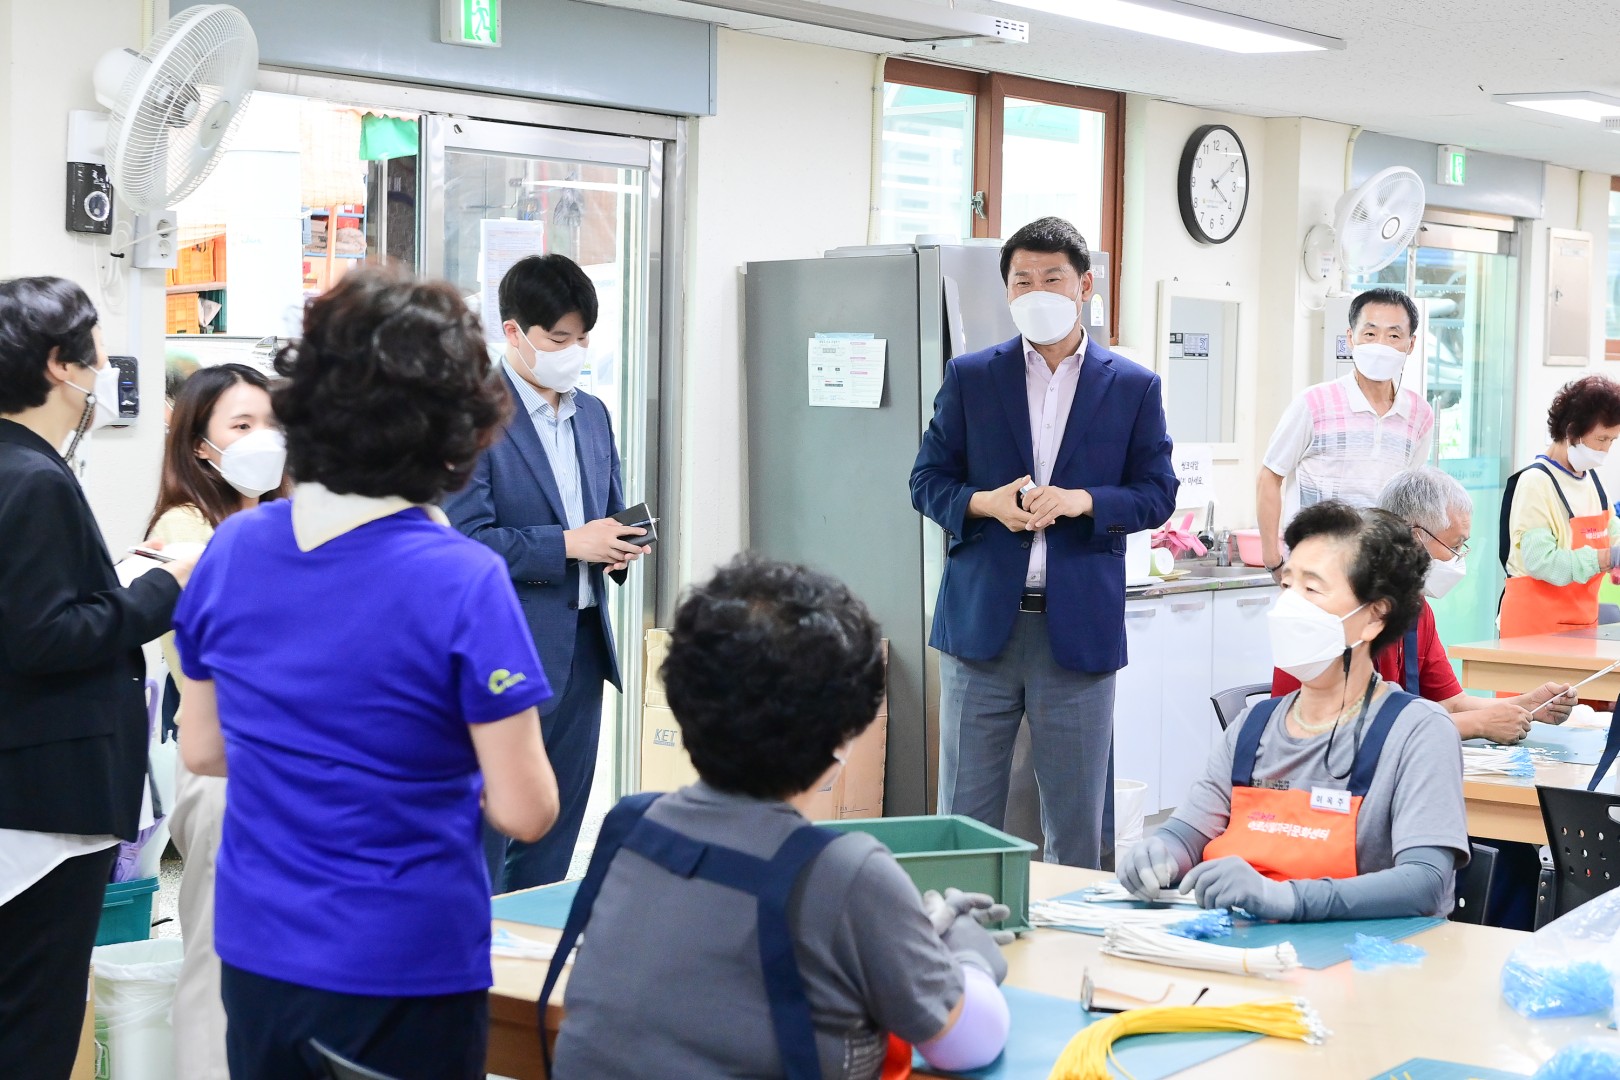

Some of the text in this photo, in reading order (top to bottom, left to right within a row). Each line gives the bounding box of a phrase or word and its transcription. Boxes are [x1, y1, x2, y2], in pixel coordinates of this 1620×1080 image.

[1203, 144, 1209, 154] 11
[1213, 140, 1220, 151] 12
[1195, 158, 1202, 168] 10
[1193, 197, 1198, 208] 8
[1200, 212, 1205, 223] 7
[1219, 214, 1224, 225] 5
[1210, 218, 1214, 229] 6
[655, 728, 678, 741] KET
